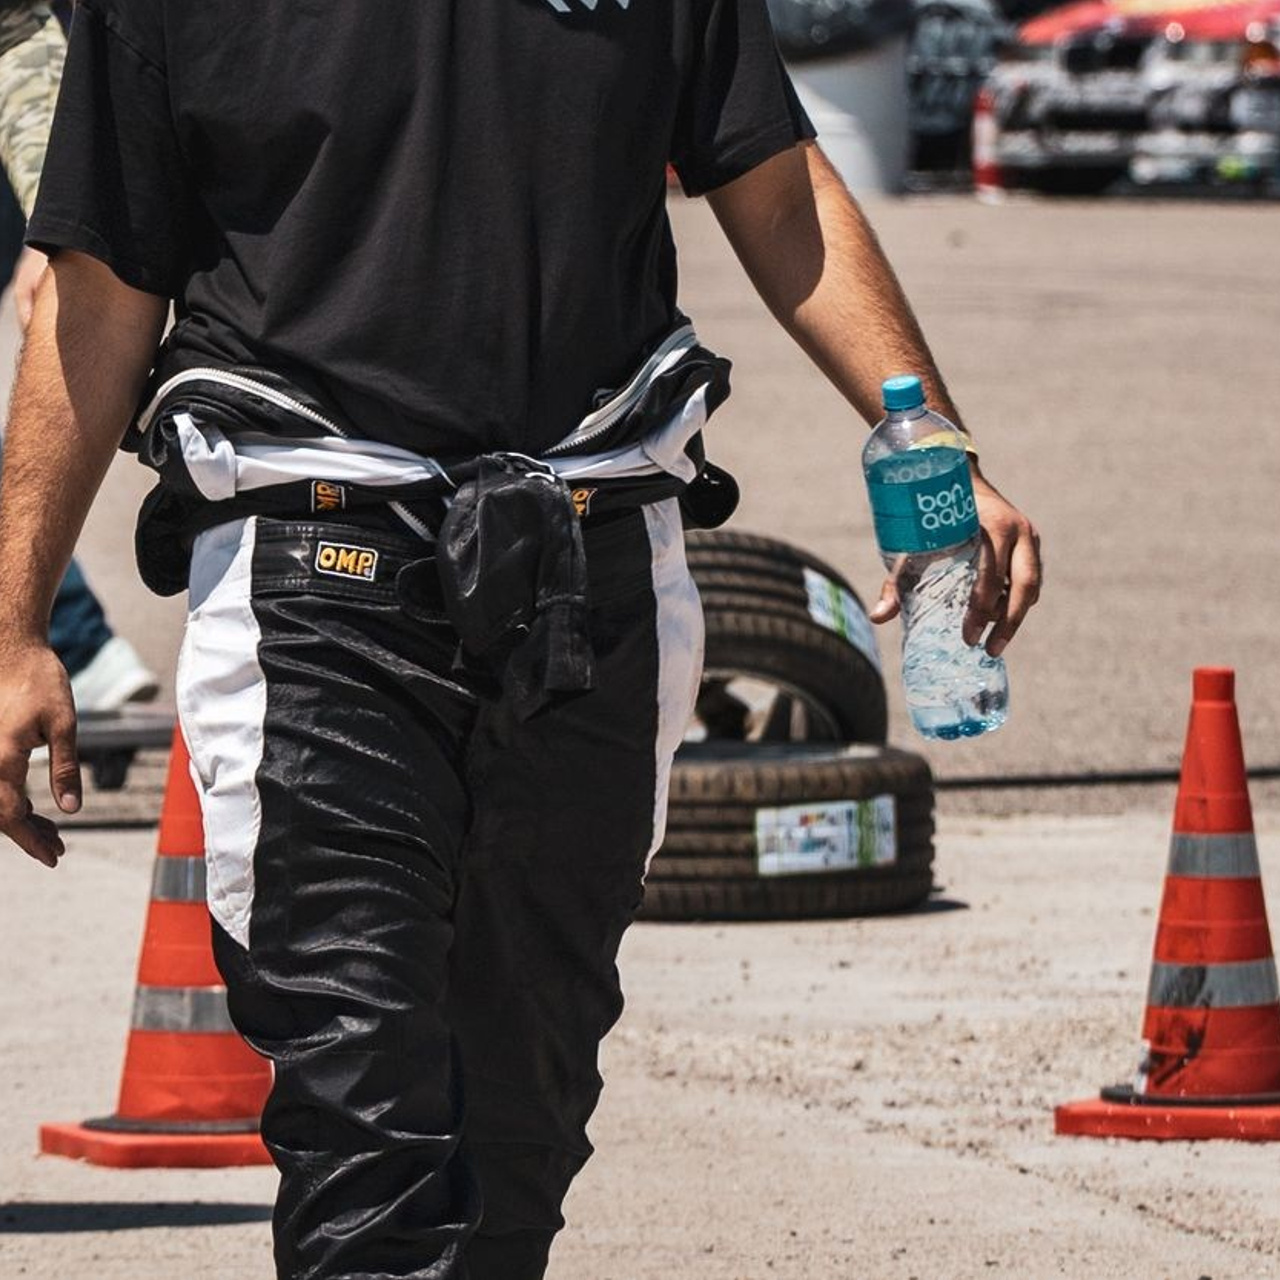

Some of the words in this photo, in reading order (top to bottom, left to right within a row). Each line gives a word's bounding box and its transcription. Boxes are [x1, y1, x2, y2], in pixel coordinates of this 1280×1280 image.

[916, 483, 964, 512] bon
[921, 495, 975, 530] aqua
[319, 547, 373, 575] OMP
